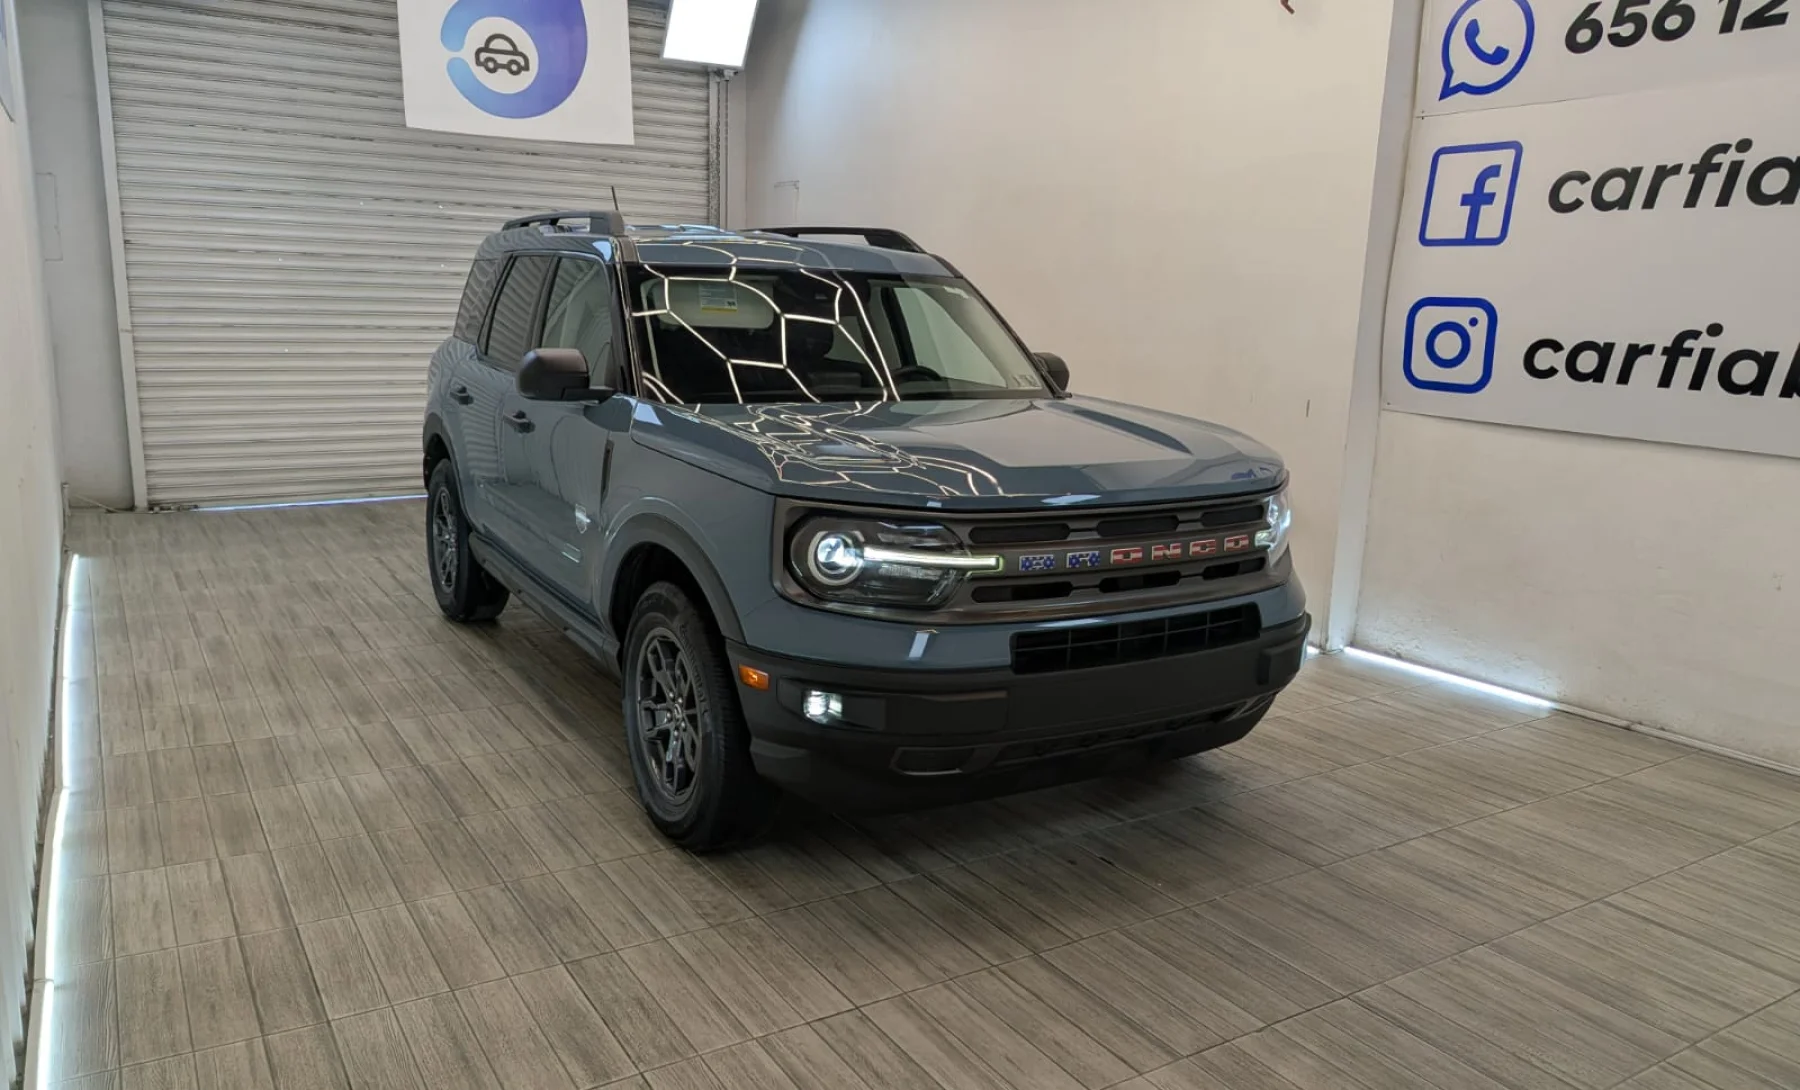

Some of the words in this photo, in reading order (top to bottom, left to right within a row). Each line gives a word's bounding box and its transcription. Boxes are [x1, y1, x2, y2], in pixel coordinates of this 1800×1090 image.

[1564, 0, 1696, 54] 656
[1548, 138, 1800, 214] carfia
[1019, 534, 1250, 572] BRONCO
